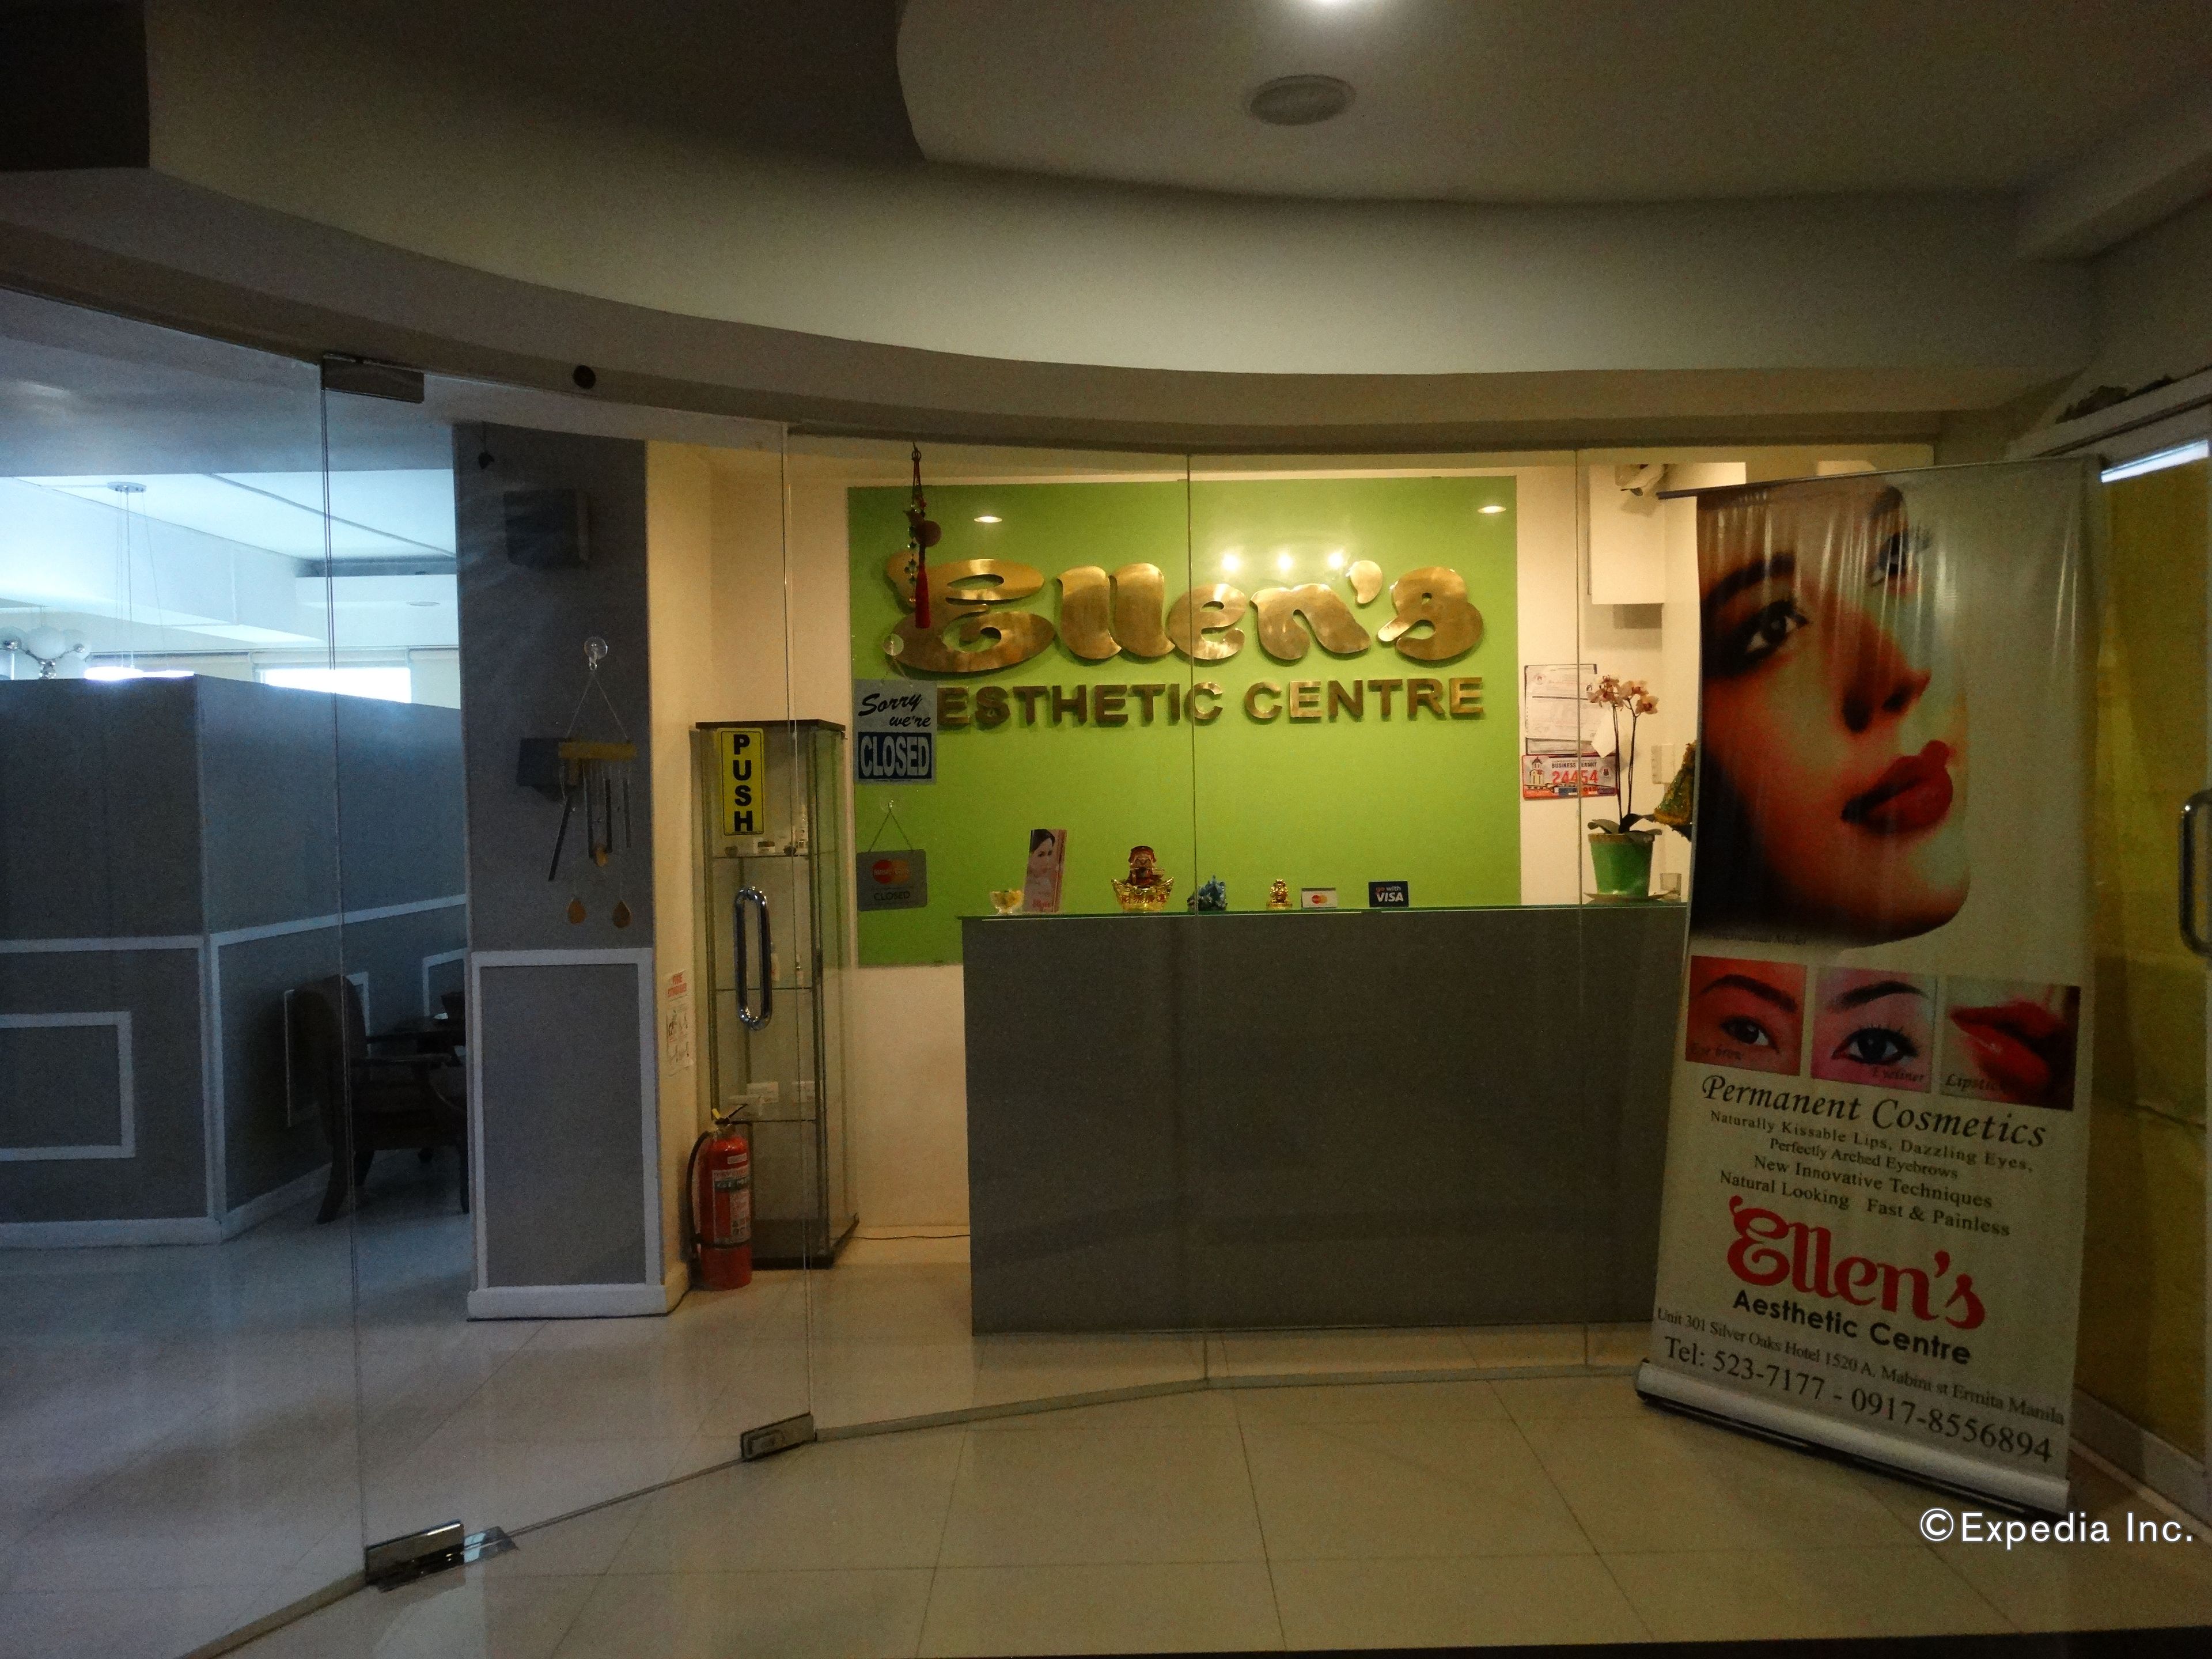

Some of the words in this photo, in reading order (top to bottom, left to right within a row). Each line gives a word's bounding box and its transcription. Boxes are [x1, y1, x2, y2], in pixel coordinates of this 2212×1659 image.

[888, 551, 1483, 673] Ellen's
[858, 693, 922, 716] Sorry
[889, 715, 931, 727] we're
[937, 682, 1223, 727] ESTHETIC
[1245, 677, 1484, 719] CENTRE
[733, 734, 753, 831] PUSH
[860, 735, 930, 777] CLOSED
[1552, 770, 1599, 785] 24454
[873, 891, 910, 900] CLOSED
[1376, 892, 1404, 902] VISA
[1702, 1075, 1861, 1120] Permanent
[1873, 1099, 2046, 1147] Cosmetics
[1711, 1111, 1774, 1133] Naturally
[1782, 1122, 1846, 1142] Kissable
[1854, 1132, 1892, 1151] Lips,
[1901, 1139, 1976, 1165] Dazzling
[1770, 1138, 1827, 1160] Perfectly
[1831, 1149, 1881, 1166] Arched
[1887, 1156, 1958, 1179] Eyebrows
[1721, 1170, 1775, 1192] Natural
[1782, 1183, 1849, 1210] Looking
[1868, 1198, 1903, 1217] Fast
[1909, 1205, 1925, 1221] &
[1933, 1210, 2010, 1236] Painless
[1754, 1155, 1789, 1172] New
[1796, 1162, 1883, 1190] Innovative
[1889, 1177, 1992, 1207] Techniques
[1728, 1195, 1986, 1329] Ellen's
[1733, 1290, 1858, 1338] Aesthetic
[1870, 1322, 1971, 1364] Centre
[1657, 1308, 1683, 1325] Unit
[1687, 1315, 1705, 1331] 301
[1710, 1322, 1746, 1342] Silver
[1749, 1332, 1781, 1351] Oaks
[1786, 1342, 1820, 1362] Hotel
[1826, 1352, 1858, 1372] 1520
[1953, 1384, 2003, 1410] Ermita
[2009, 1397, 2065, 1425] Manila
[1665, 1336, 1704, 1366] Tel:
[1713, 1350, 1824, 1400] 523-7177
[1851, 1388, 2051, 1463] 0917-8556894
